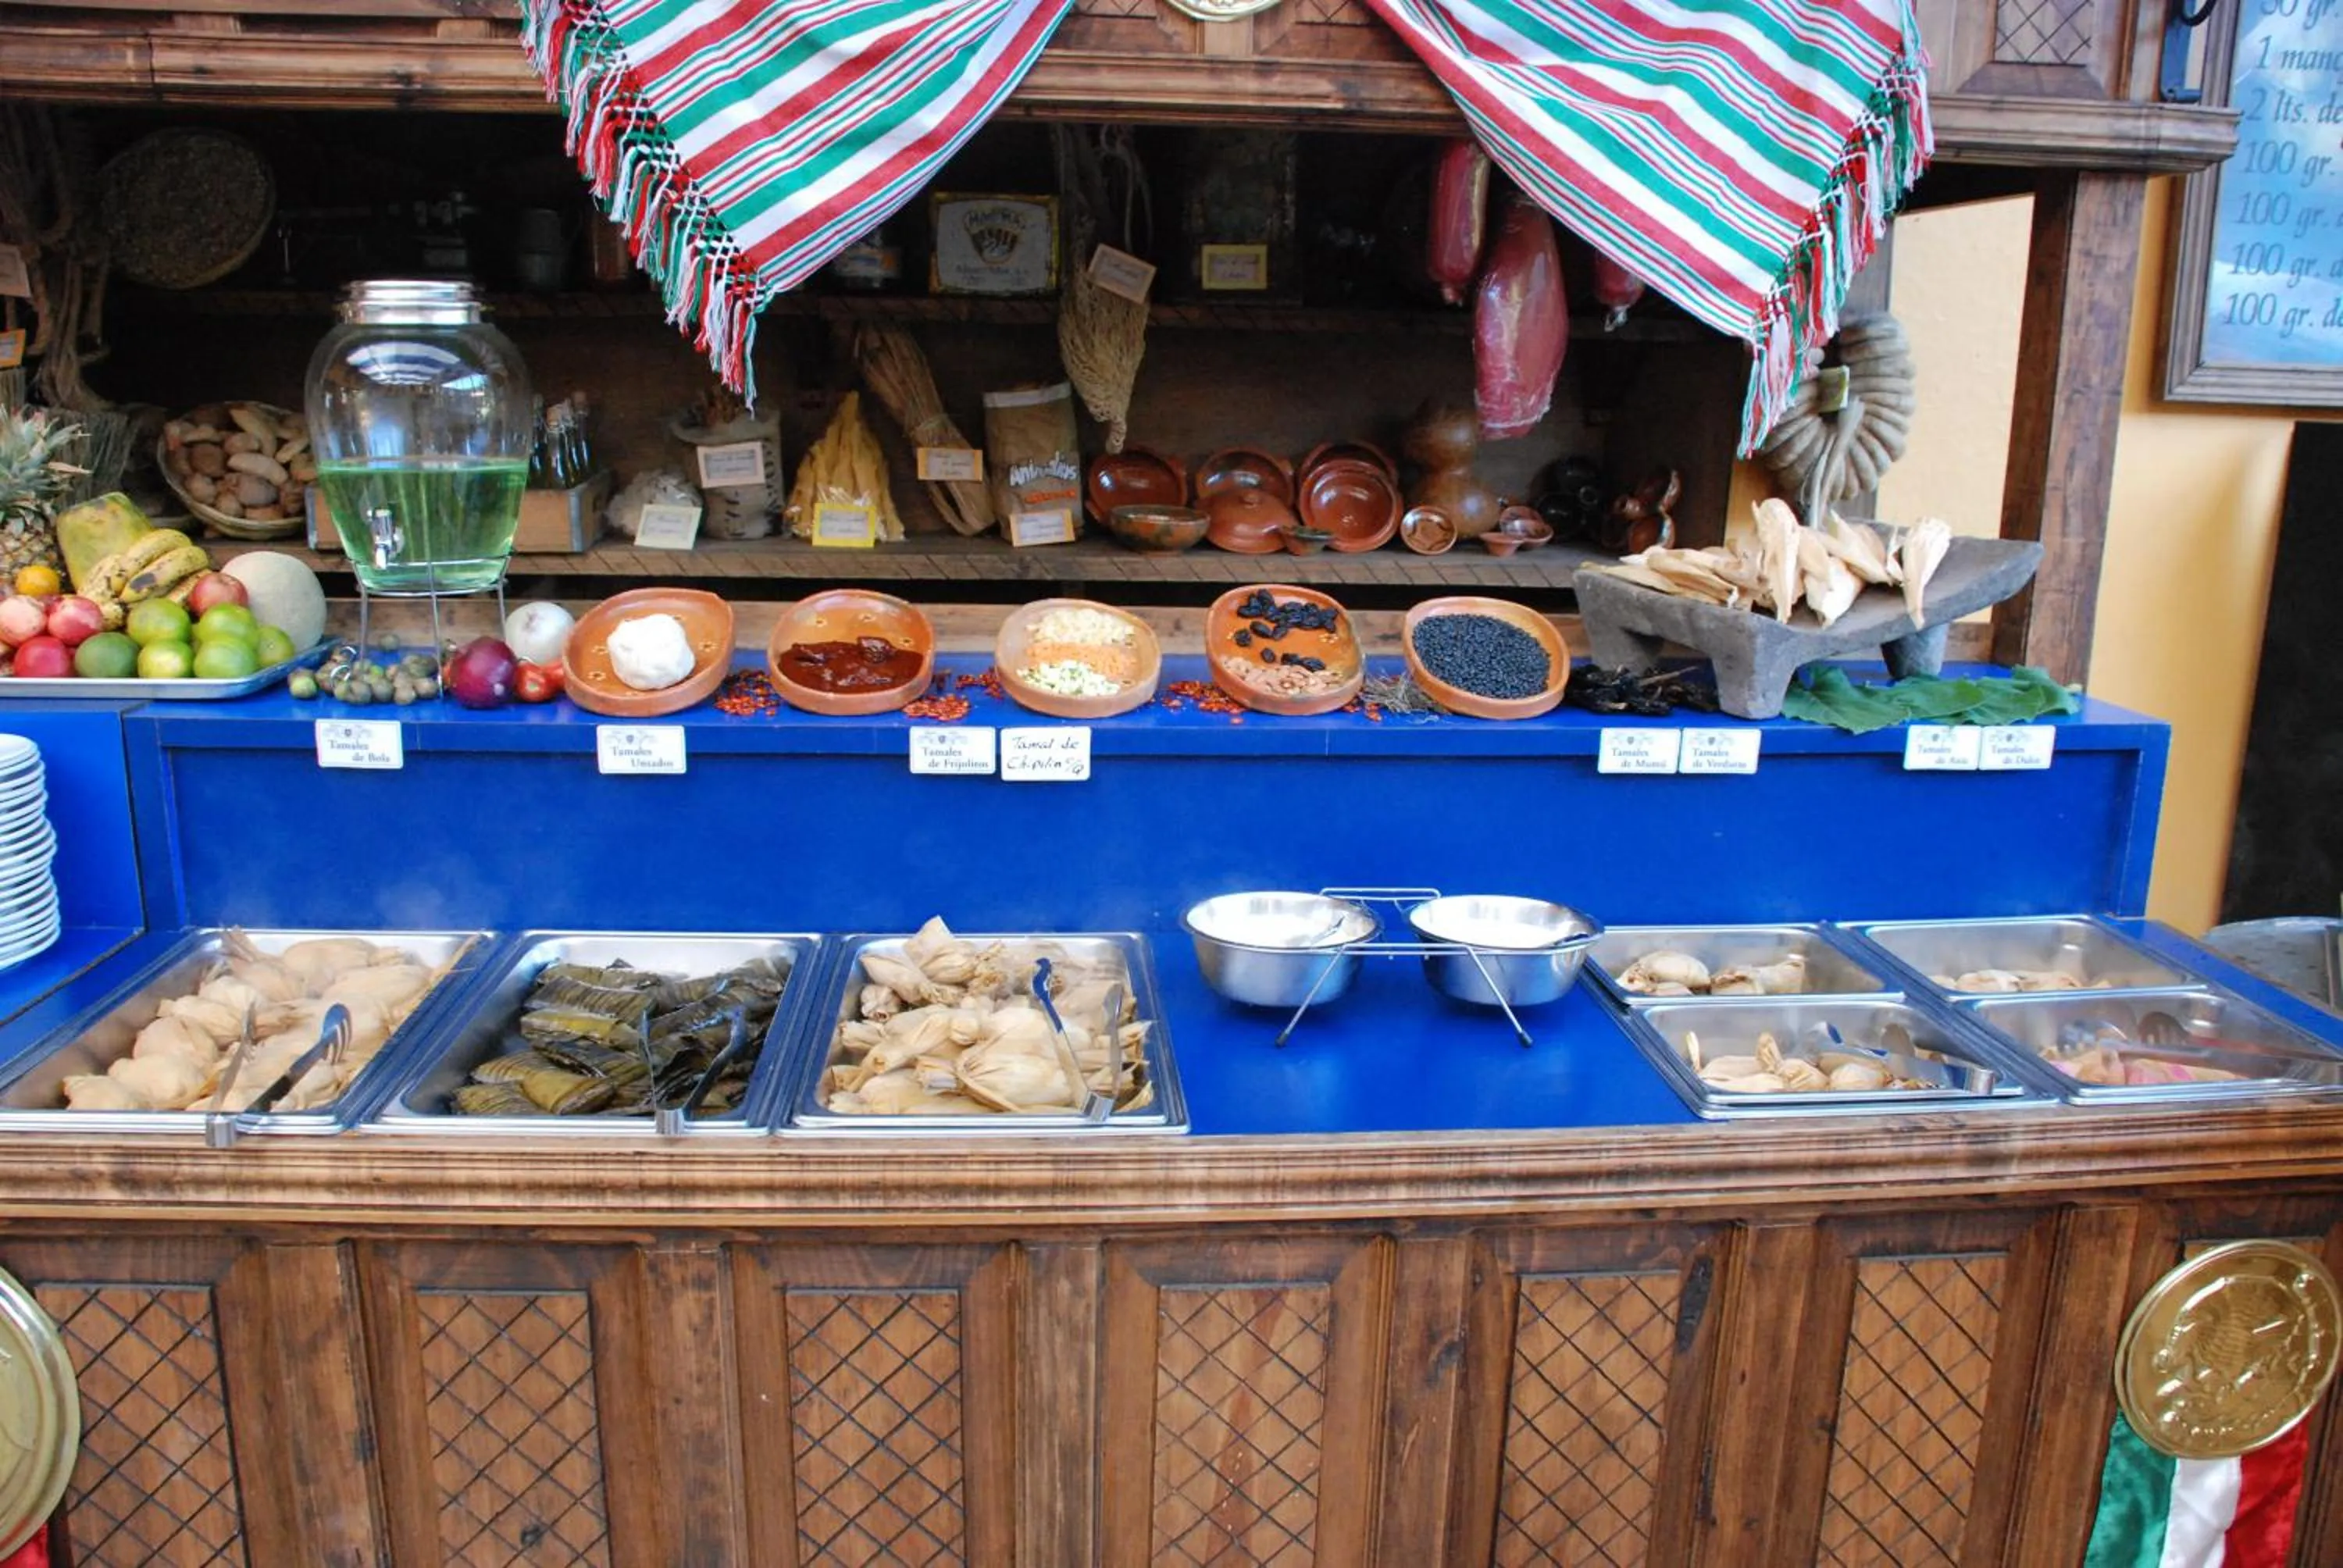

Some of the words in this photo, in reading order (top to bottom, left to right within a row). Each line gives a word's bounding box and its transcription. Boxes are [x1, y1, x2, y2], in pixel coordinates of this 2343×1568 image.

[2256, 35, 2272, 69] 1
[2245, 87, 2269, 121] 2
[2241, 141, 2298, 174] 100
[2300, 154, 2335, 188] gr.
[2233, 191, 2291, 226] 100
[2293, 207, 2330, 238] gr.
[2229, 241, 2285, 276] 100
[2287, 257, 2321, 288] gr.
[2224, 292, 2277, 326] 100
[2279, 306, 2313, 338] gr.
[327, 738, 369, 750] Tamales
[1012, 736, 1055, 750] Tamal
[1061, 736, 1080, 750] de
[609, 746, 653, 757] Tamales
[921, 746, 963, 757] Tamales
[1611, 747, 1649, 757] Tamales
[1692, 747, 1729, 757] Tamales
[927, 757, 941, 768] de
